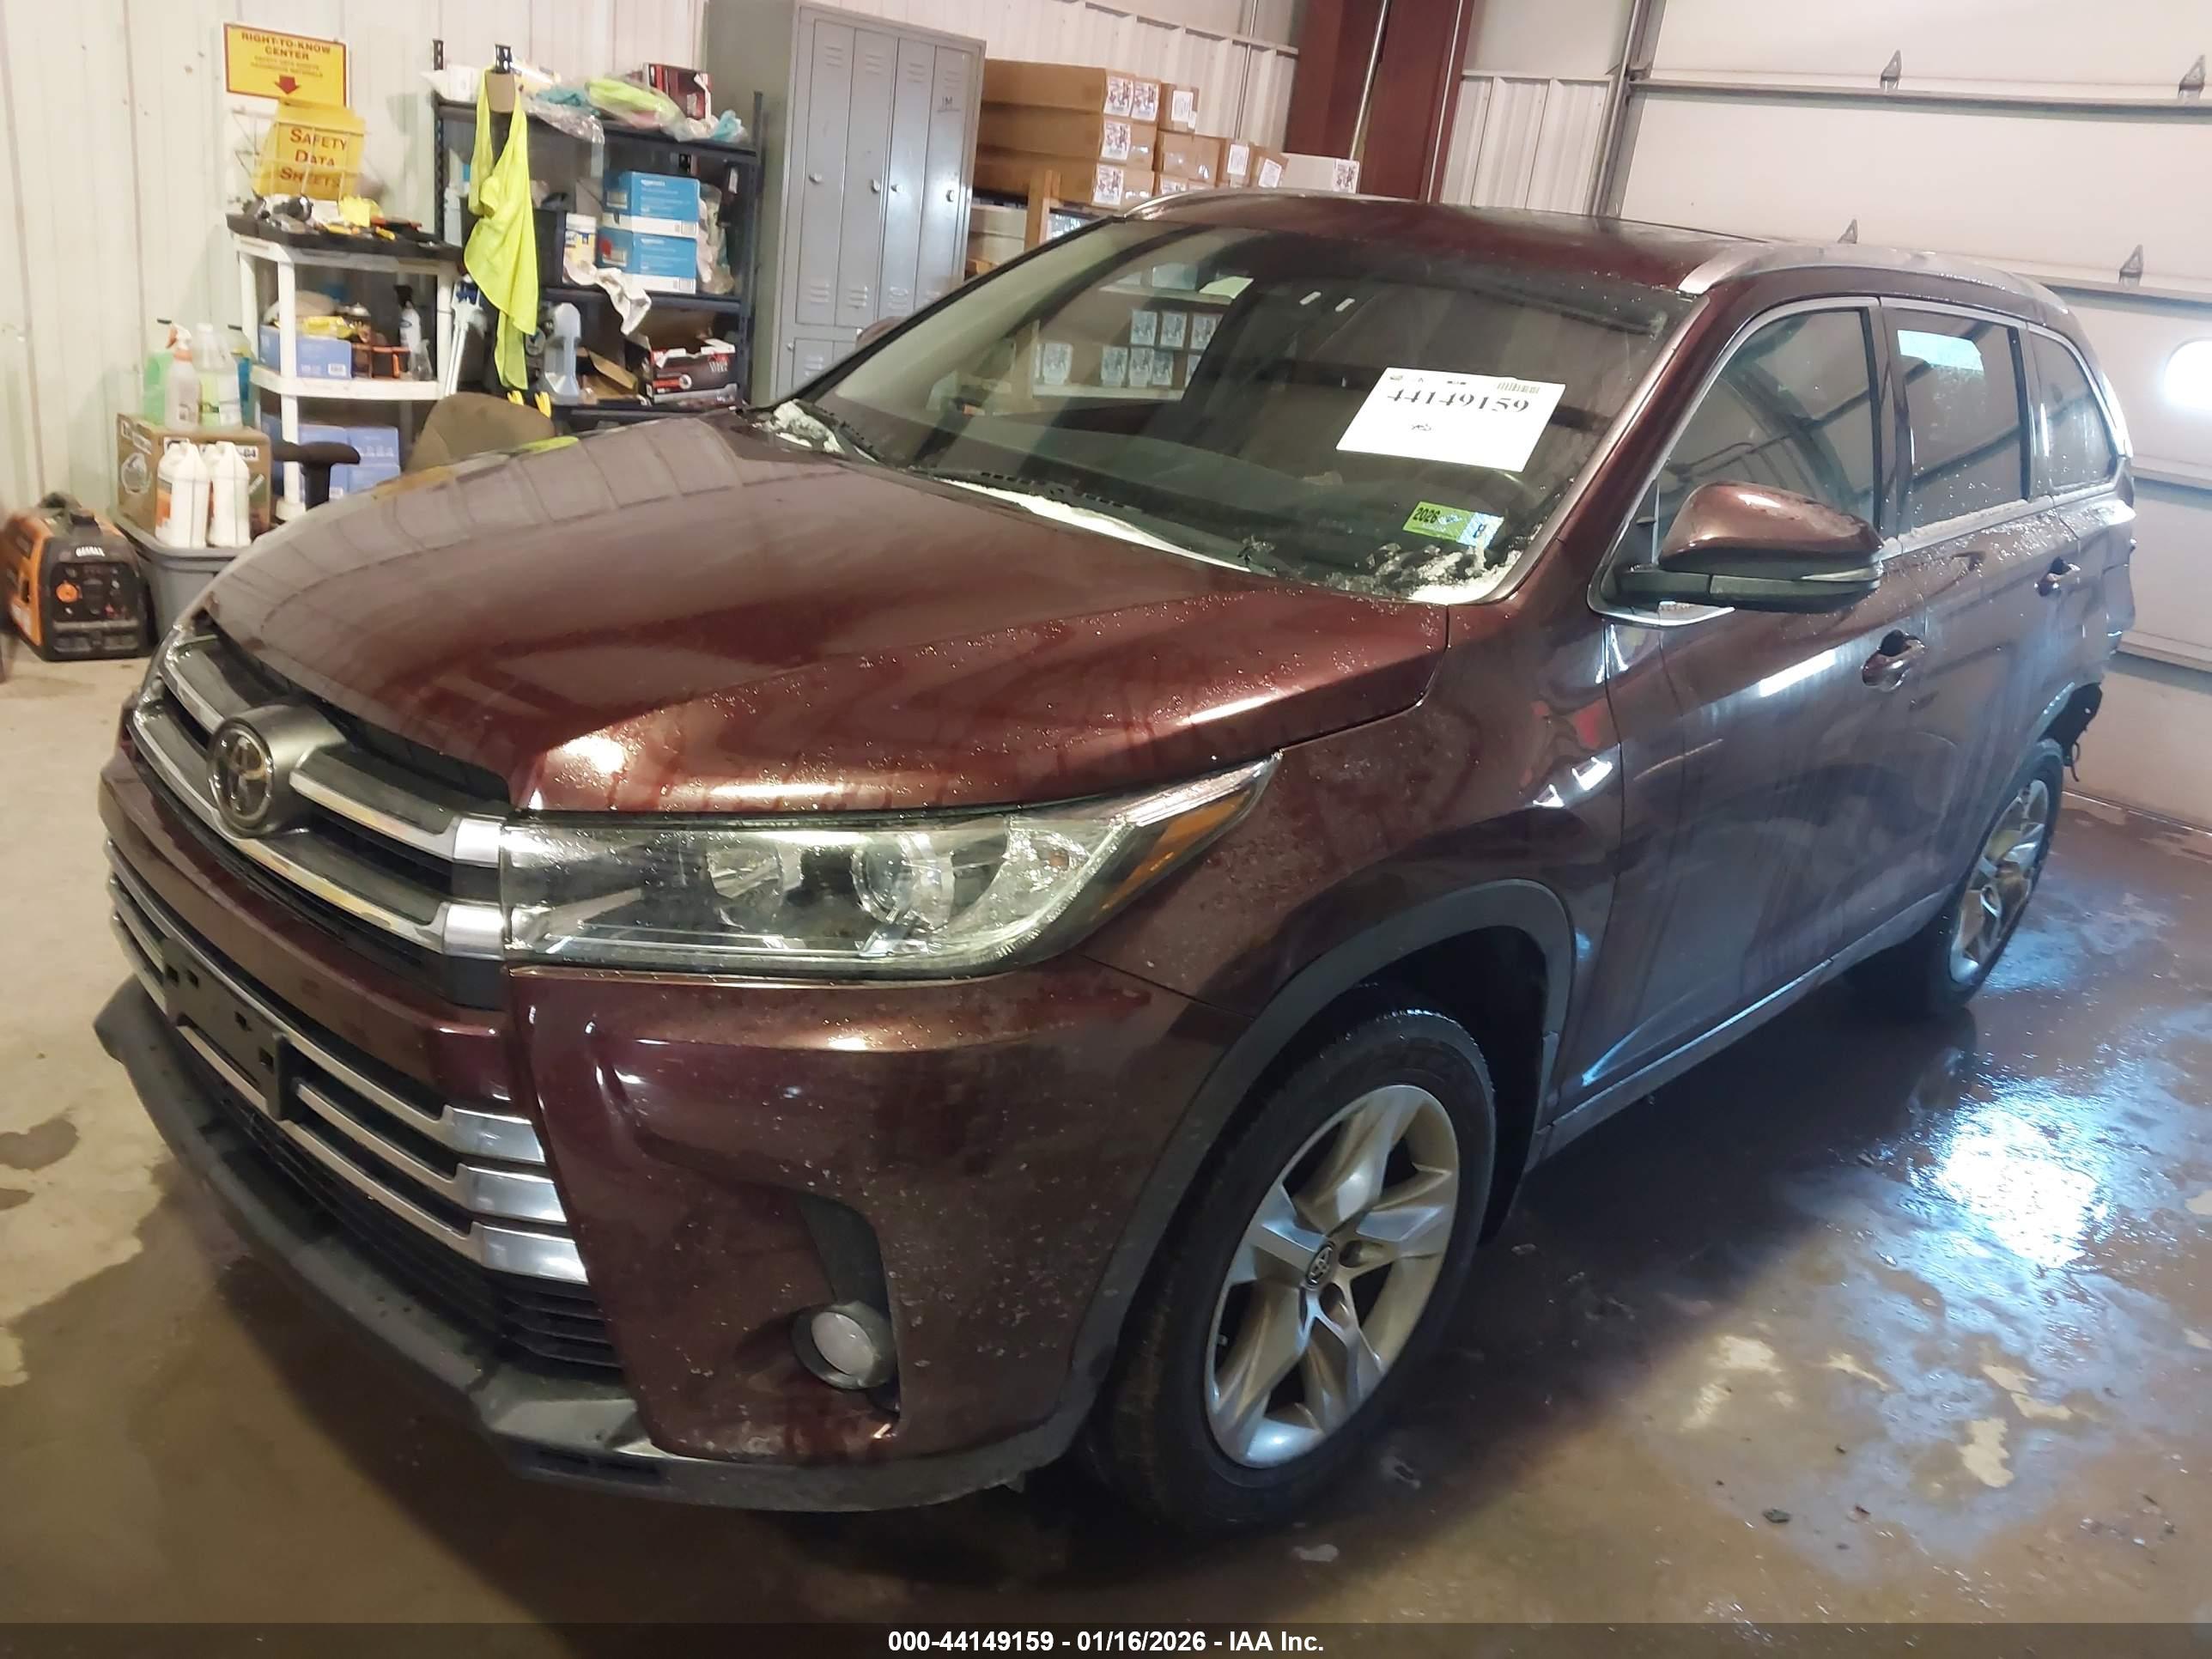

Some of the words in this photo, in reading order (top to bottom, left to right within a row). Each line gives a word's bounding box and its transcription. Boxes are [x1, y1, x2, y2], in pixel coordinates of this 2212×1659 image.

[241, 33, 331, 54] RIGHT-TO-KNOW
[264, 46, 309, 60] CENTER
[290, 128, 347, 150] SAFETY
[295, 149, 335, 166] DATA
[1388, 389, 1529, 412] 44149159
